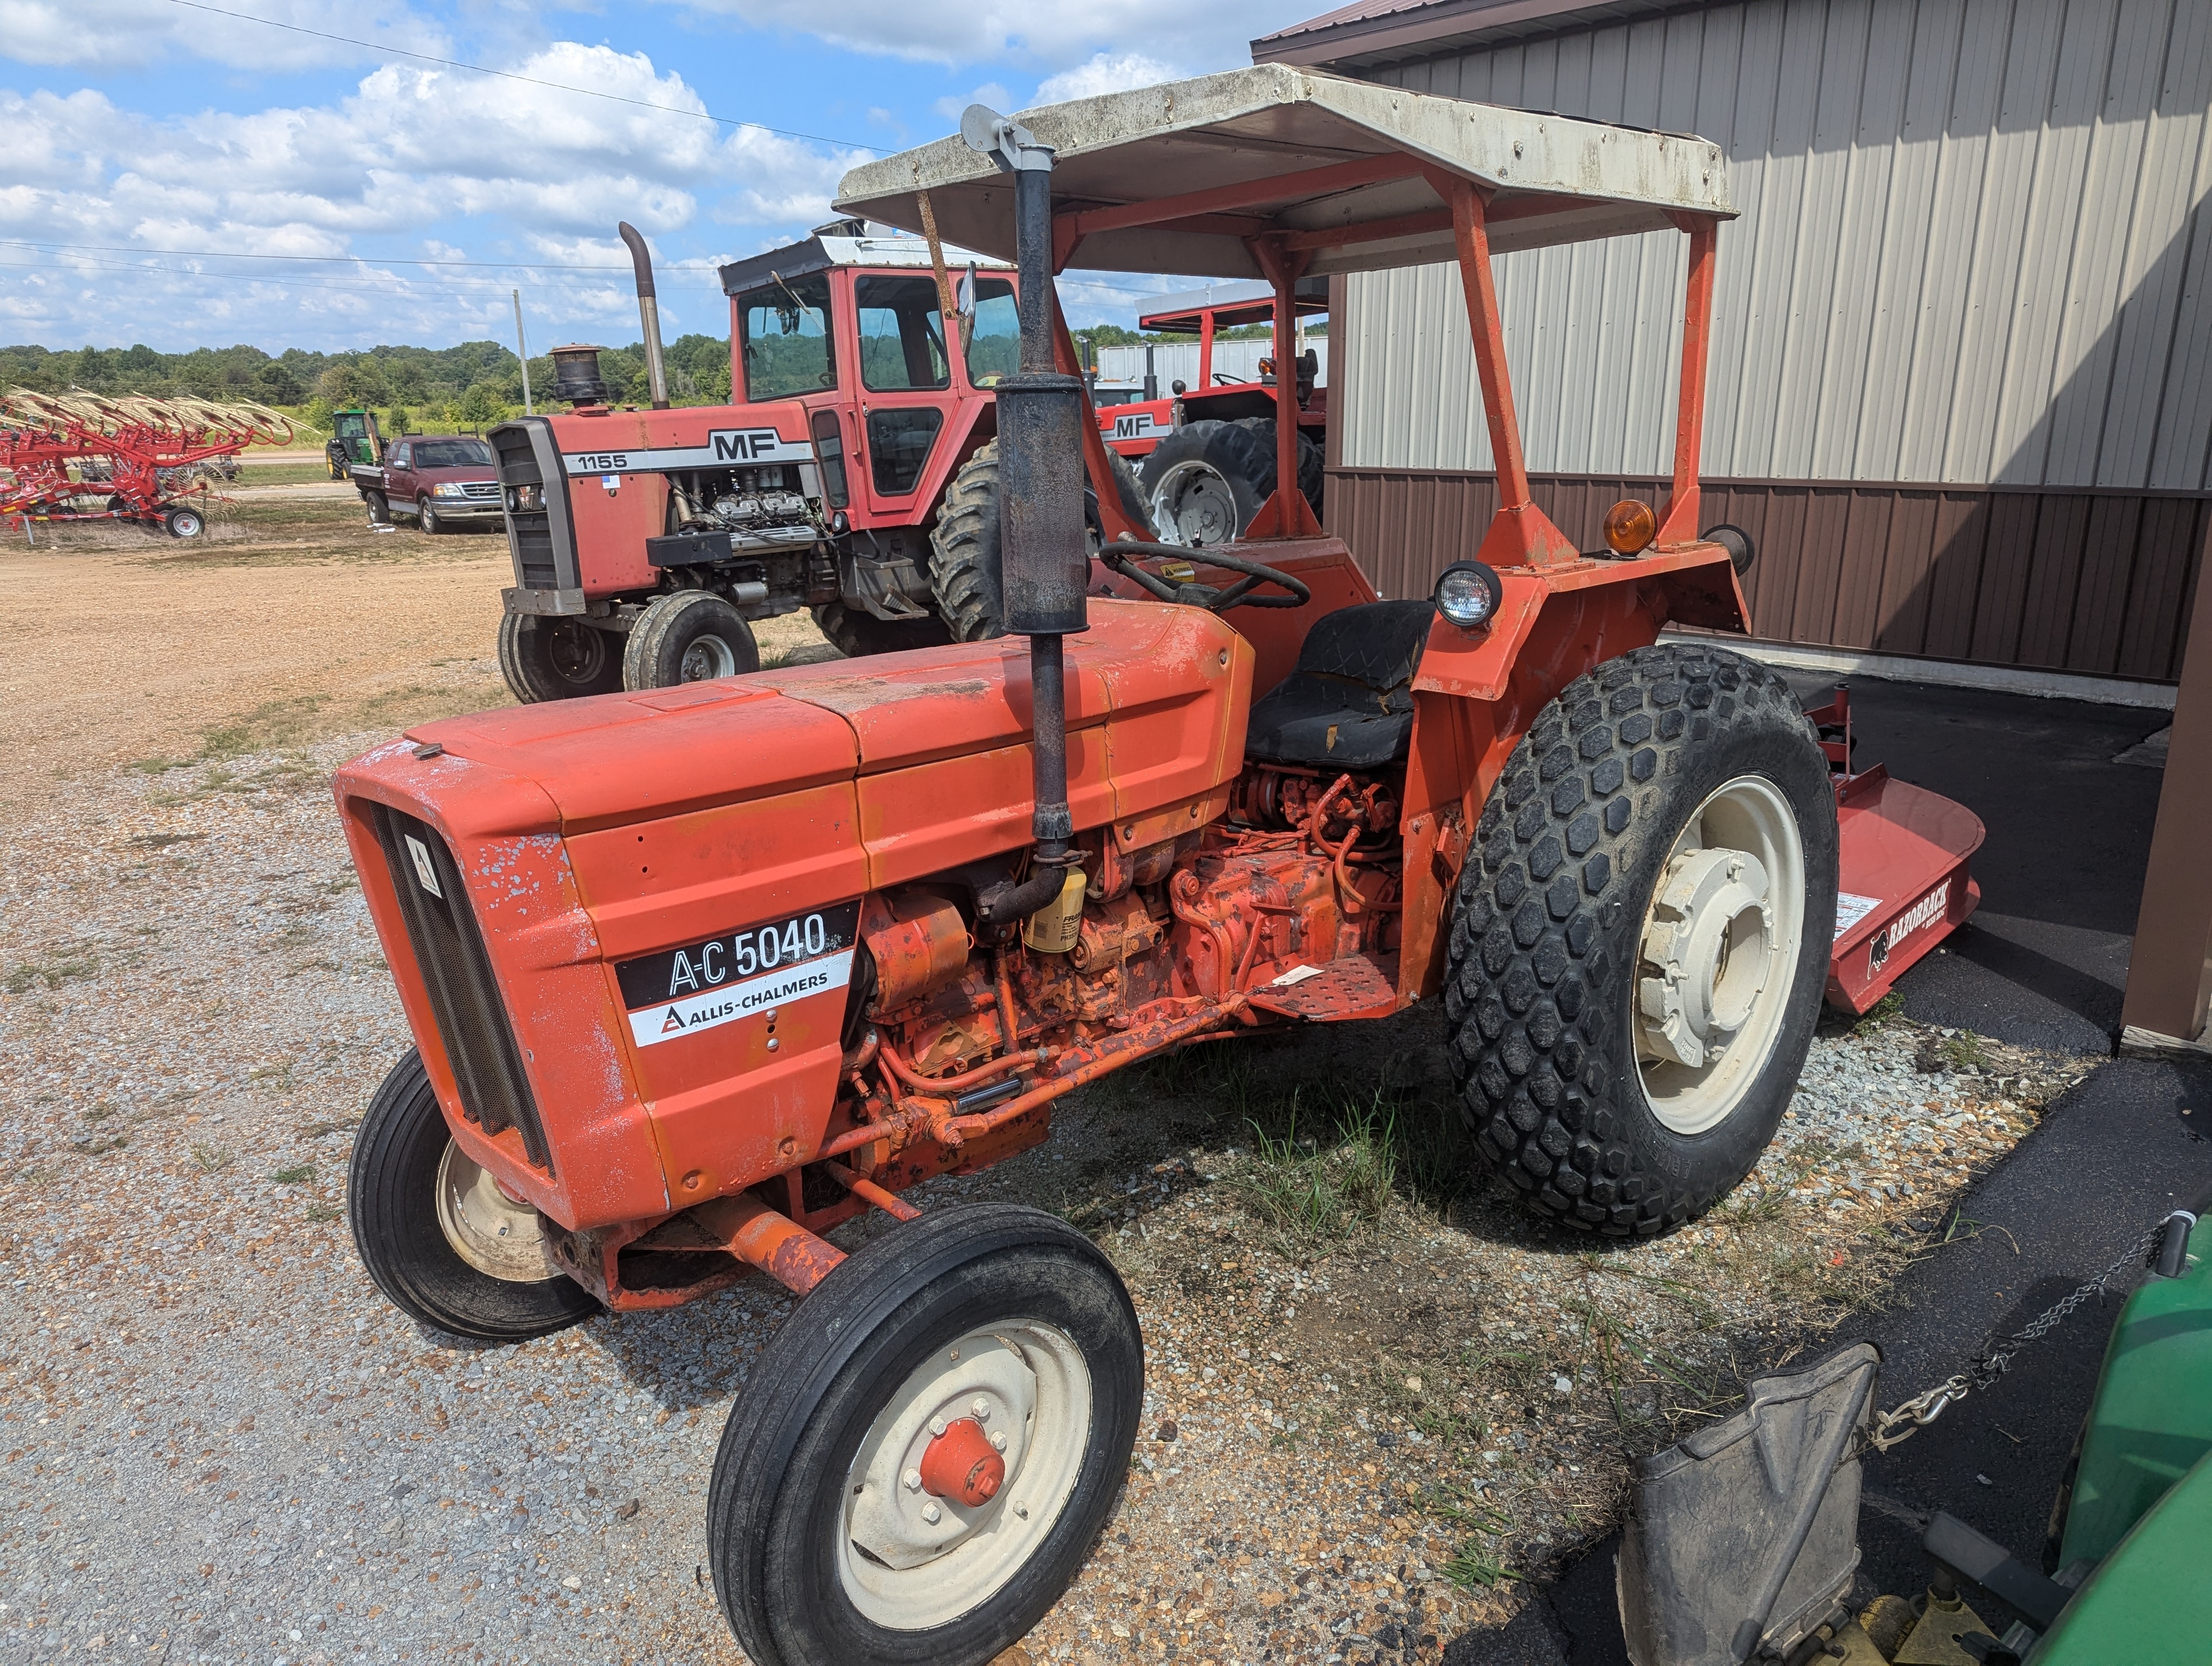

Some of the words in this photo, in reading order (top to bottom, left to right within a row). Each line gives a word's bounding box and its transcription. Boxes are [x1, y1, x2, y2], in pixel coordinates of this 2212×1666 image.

[713, 433, 776, 460] MF
[1117, 416, 1150, 438] MF
[578, 454, 628, 470] 1155
[1063, 910, 1082, 922] FRAM
[1888, 880, 1949, 950] RAZORBACK
[735, 914, 826, 975] 5040
[689, 972, 828, 1027] ALLIS-CHALMERS
[1021, 1521, 1077, 1593] SERVICE
